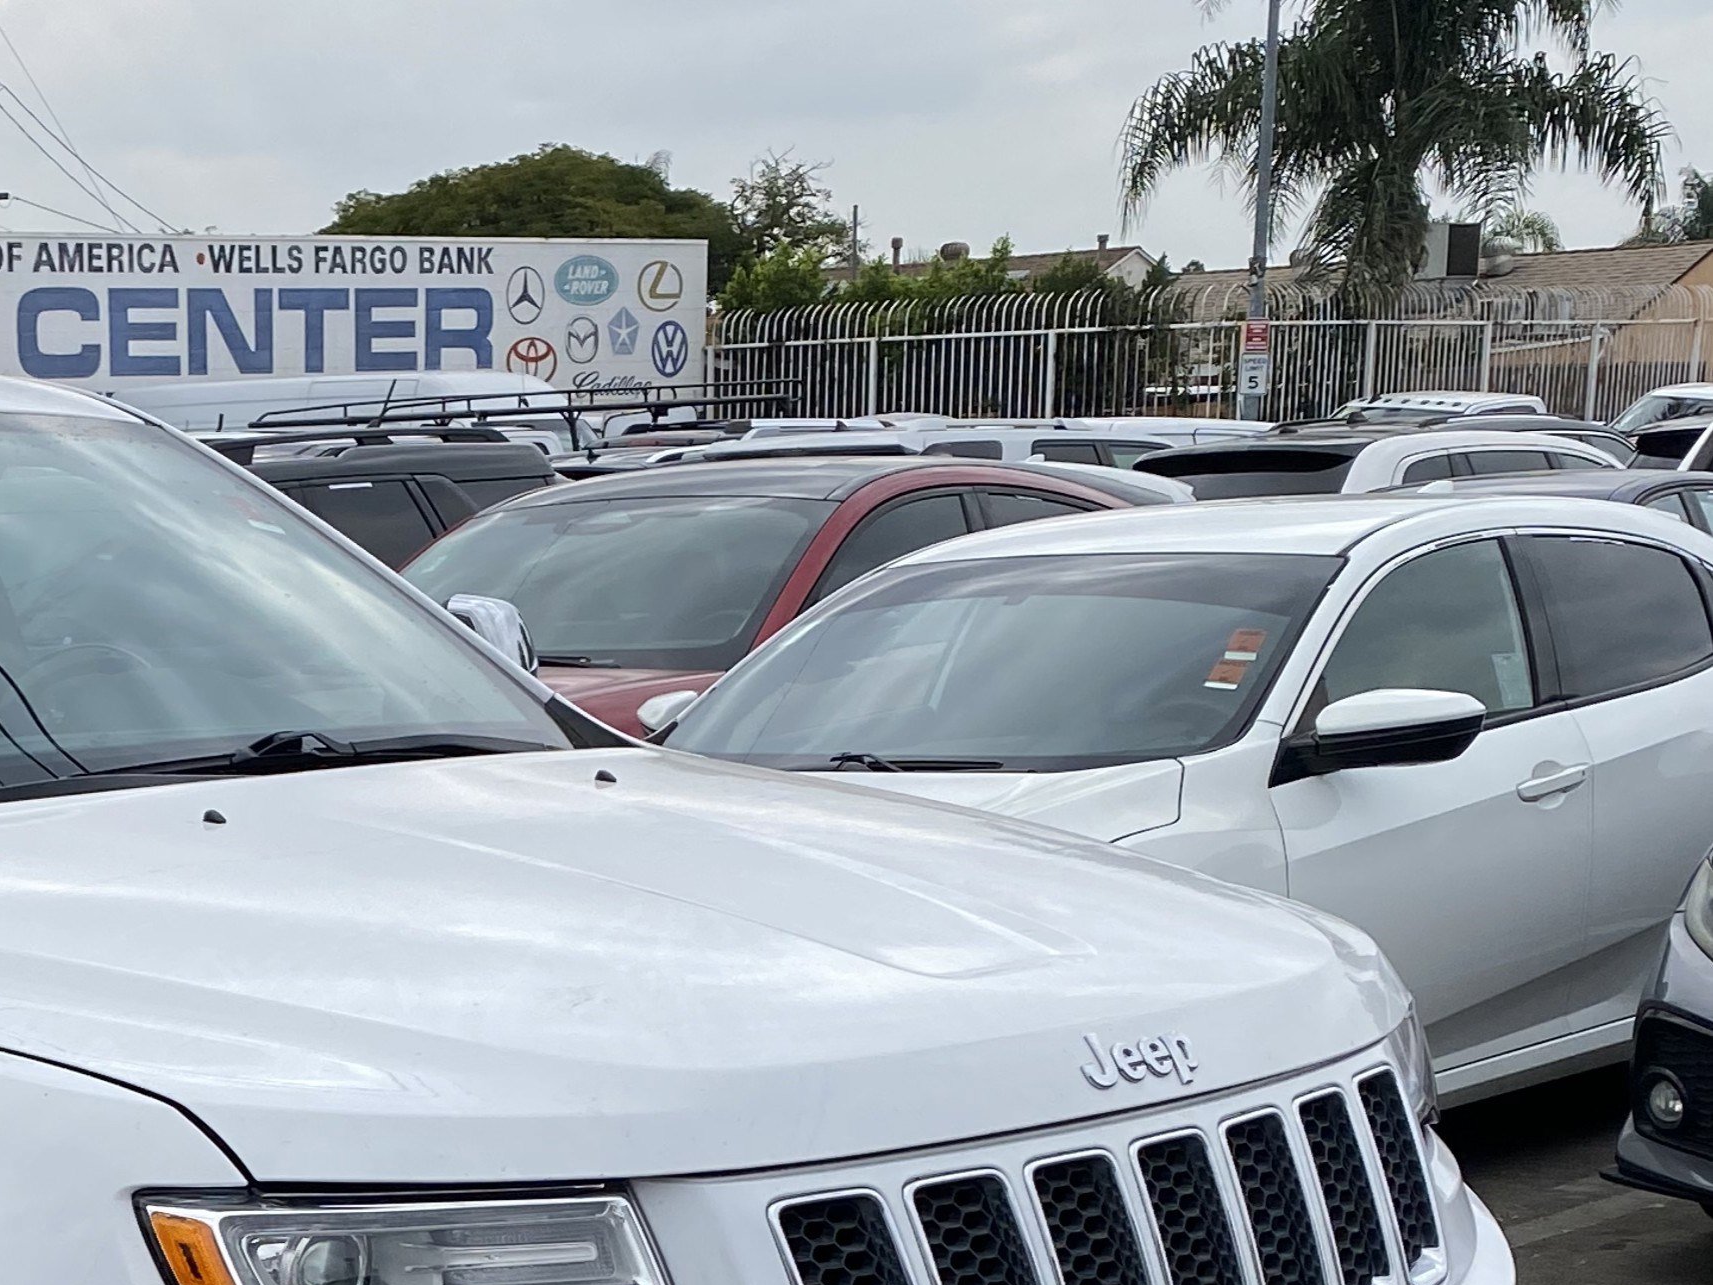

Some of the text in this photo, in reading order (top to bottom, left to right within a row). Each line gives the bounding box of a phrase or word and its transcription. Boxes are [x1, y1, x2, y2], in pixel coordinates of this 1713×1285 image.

[32, 242, 180, 275] AMERICA
[208, 244, 495, 276] WELLS FARGO BANK
[567, 264, 600, 280] LAND
[570, 280, 609, 296] ROVER
[17, 286, 495, 379] CENTER
[1247, 375, 1259, 389] 5
[1080, 1032, 1199, 1090] Jeep
